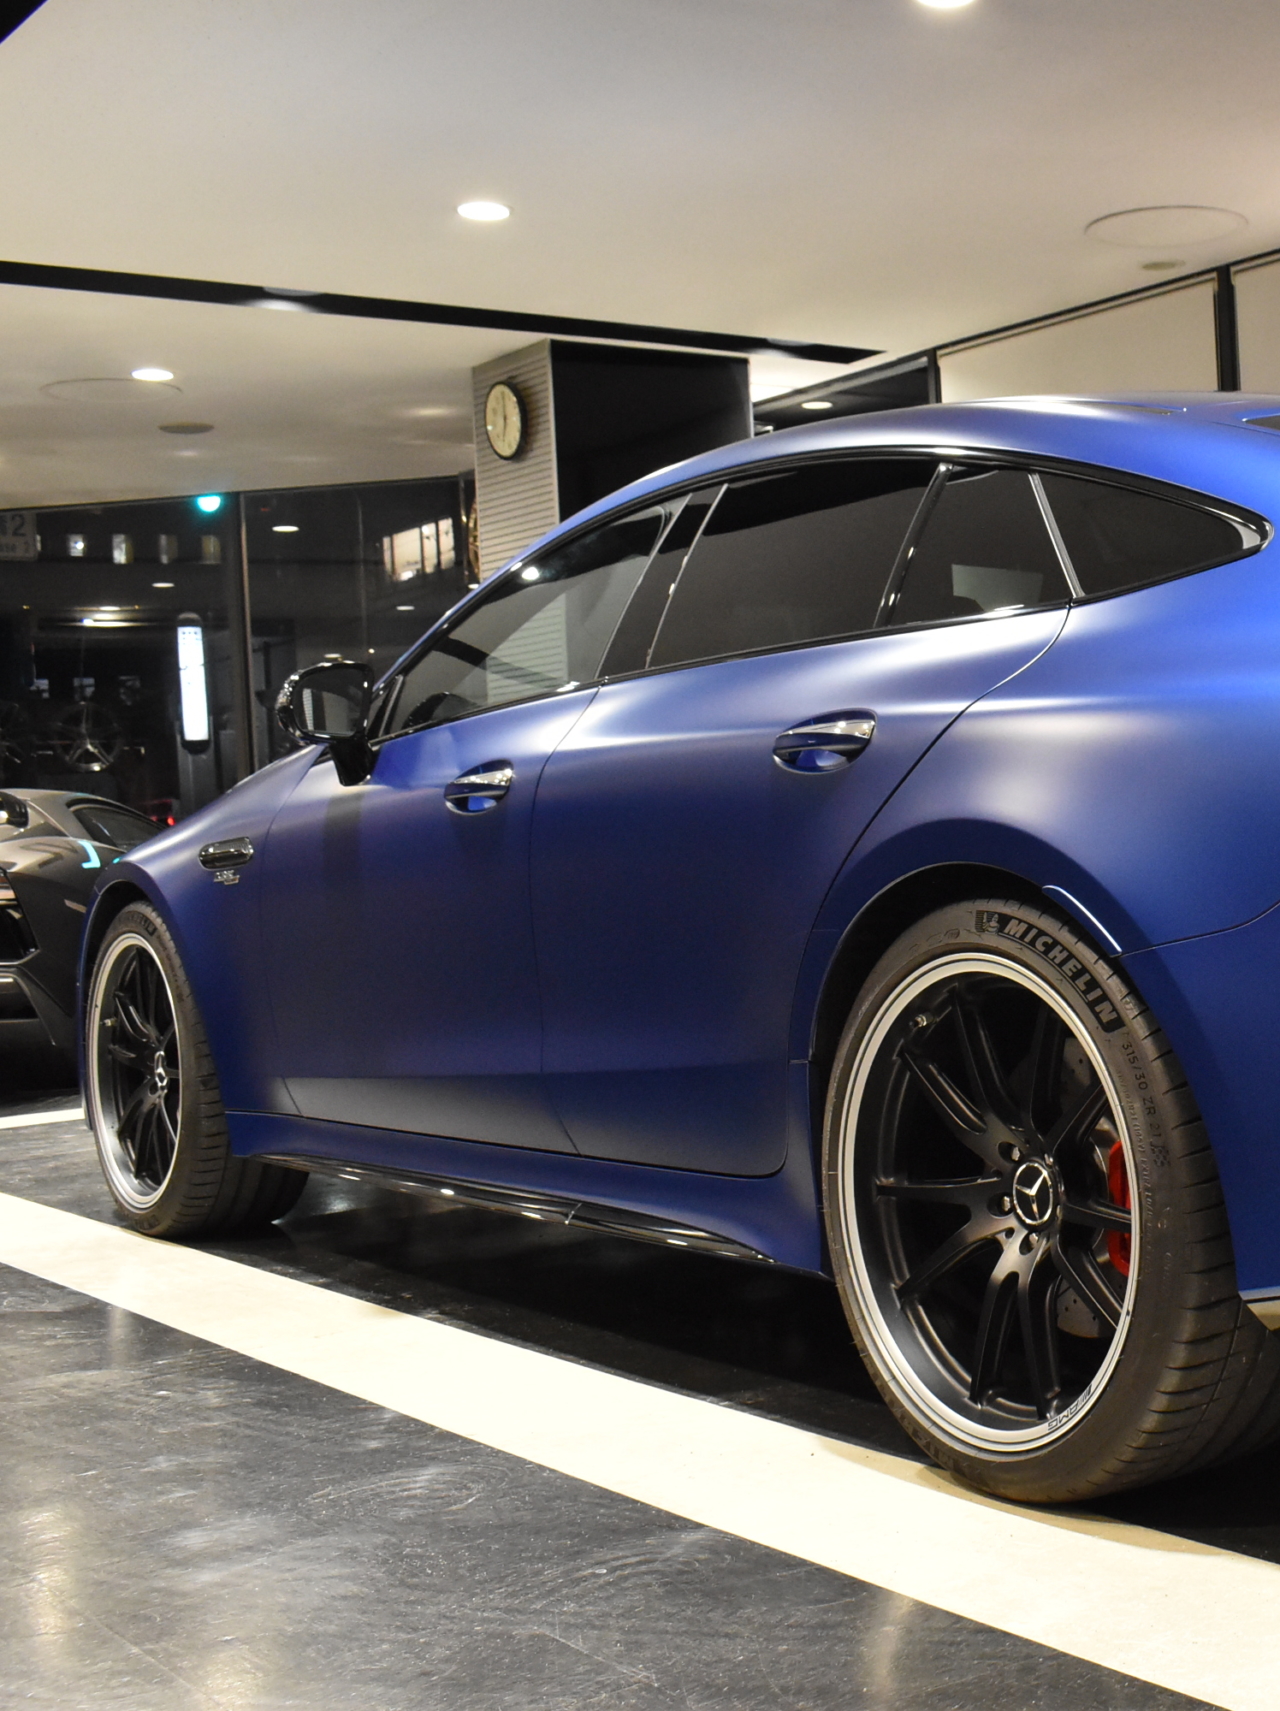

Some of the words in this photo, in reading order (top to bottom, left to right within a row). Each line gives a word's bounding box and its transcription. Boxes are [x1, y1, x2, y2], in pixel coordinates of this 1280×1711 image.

[1004, 918, 1119, 1024] MICHELIN
[1122, 1041, 1148, 1091] 315/30
[1142, 1096, 1156, 1116] ZR
[1048, 1397, 1082, 1431] AMG
